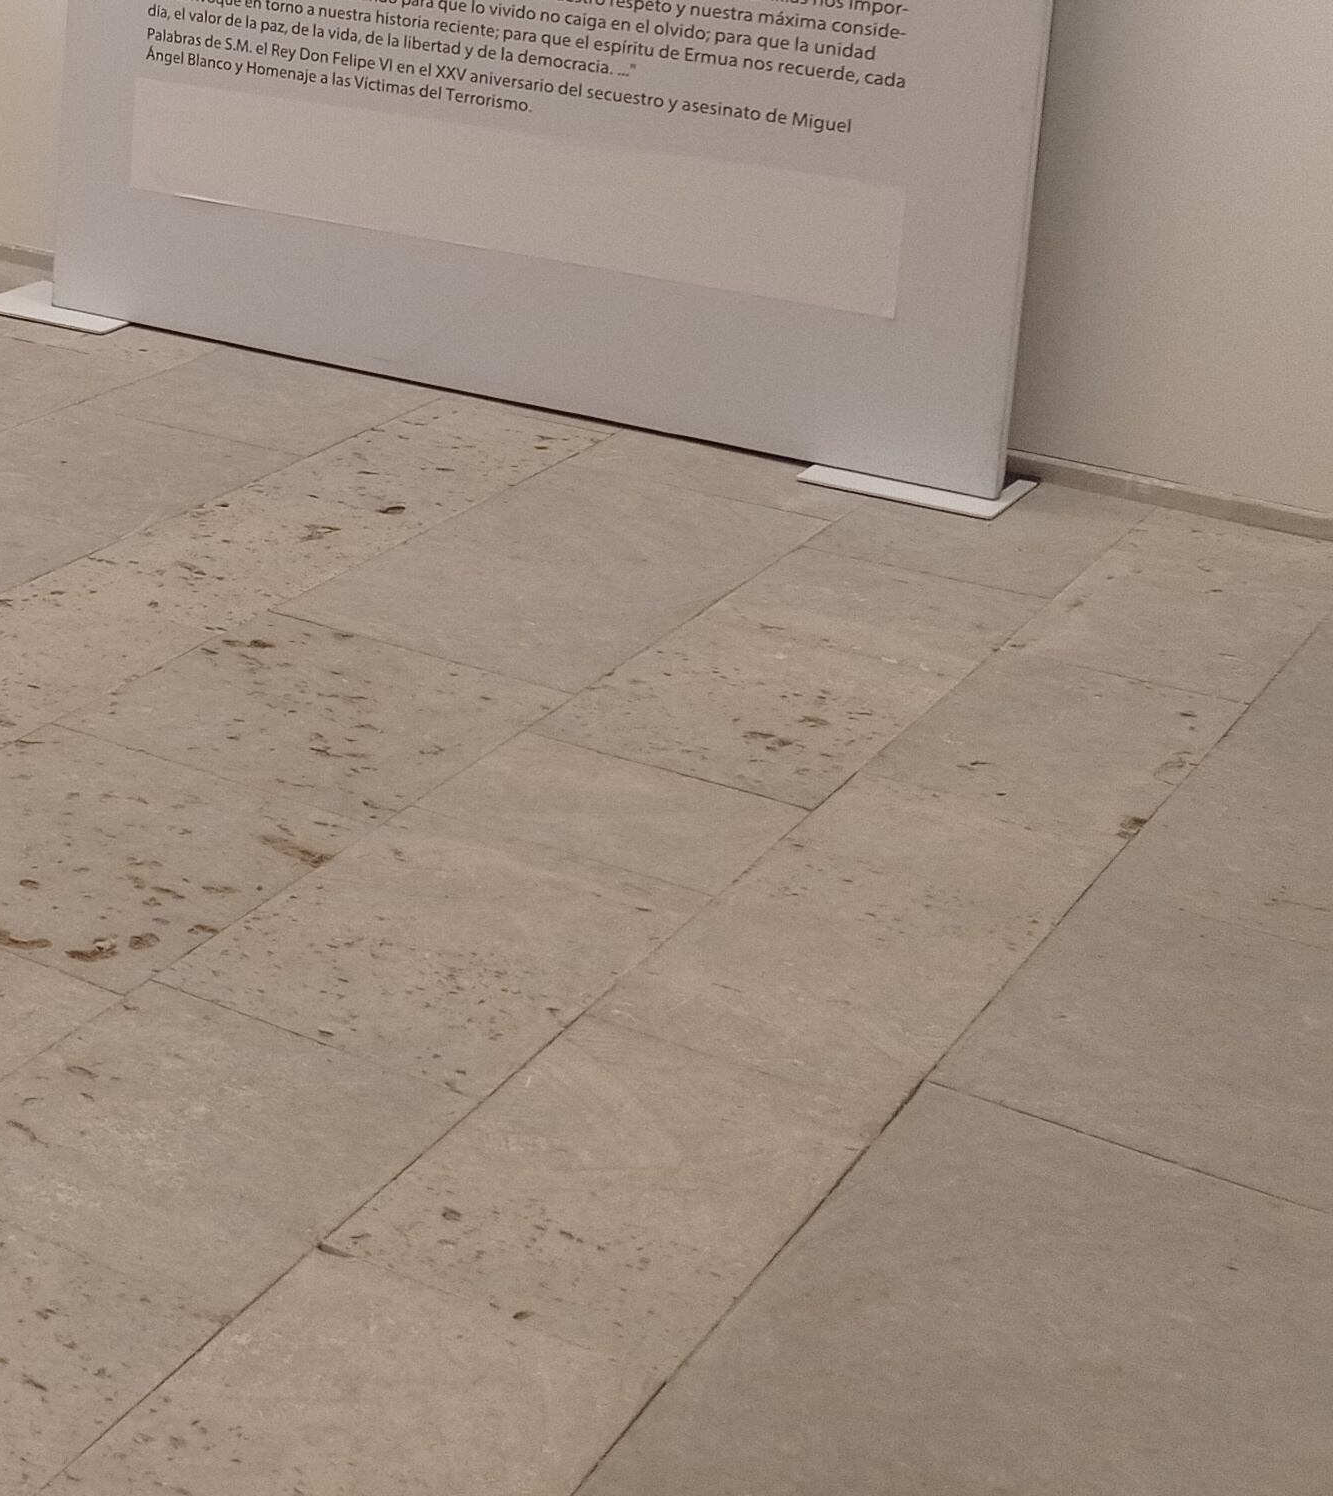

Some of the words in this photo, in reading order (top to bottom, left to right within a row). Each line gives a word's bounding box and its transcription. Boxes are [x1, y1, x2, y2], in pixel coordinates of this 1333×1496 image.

[146, 2, 171, 21] día,
[188, 9, 222, 25] valor
[224, 12, 243, 28] de
[259, 20, 289, 36] paz,
[290, 20, 310, 37] de
[327, 26, 362, 45] vida,
[364, 29, 384, 46] de
[402, 33, 462, 56] libertad
[476, 43, 497, 60] de
[516, 48, 614, 76] democracia.
[317, 6, 372, 23] nuestra
[374, 8, 430, 30] historia
[433, 19, 500, 41] reciente;
[502, 28, 537, 43] para
[540, 32, 572, 49] que
[592, 39, 655, 57] espíritu
[657, 43, 680, 61] de
[683, 46, 738, 68] Ermua
[741, 57, 774, 72] nos
[777, 61, 860, 85] recuerde,
[863, 71, 906, 89] cada
[488, 2, 536, 21] vivido
[539, 10, 561, 24] no
[563, 12, 607, 32] caiga
[610, 18, 631, 32] en
[653, 20, 711, 43] olvido;
[713, 30, 752, 46] para
[756, 35, 790, 52] que
[813, 41, 877, 61] unidad
[689, 4, 753, 23] nuestra
[757, 10, 827, 31] máxima
[830, 20, 907, 40] conside-
[144, 46, 185, 67] Ángel
[186, 51, 233, 71] Blanco
[245, 60, 317, 85] Homenaje
[331, 70, 351, 88] las
[353, 74, 416, 97] Víctimas
[418, 83, 443, 100] del
[444, 86, 533, 113] Terrorismo.
[146, 26, 202, 47] Palabras
[203, 33, 222, 50] de
[223, 36, 253, 54] S.M.
[270, 42, 297, 63] Rey
[299, 46, 329, 64] Don
[332, 50, 376, 72] Felipe
[378, 56, 393, 72] VI
[395, 62, 415, 75] en
[434, 64, 468, 81] XXV
[469, 71, 555, 94] aniversario
[557, 80, 583, 98] del
[585, 87, 665, 108] secuestro
[680, 99, 761, 121] asesinato
[764, 107, 788, 125] de
[790, 110, 853, 134] Miguel
